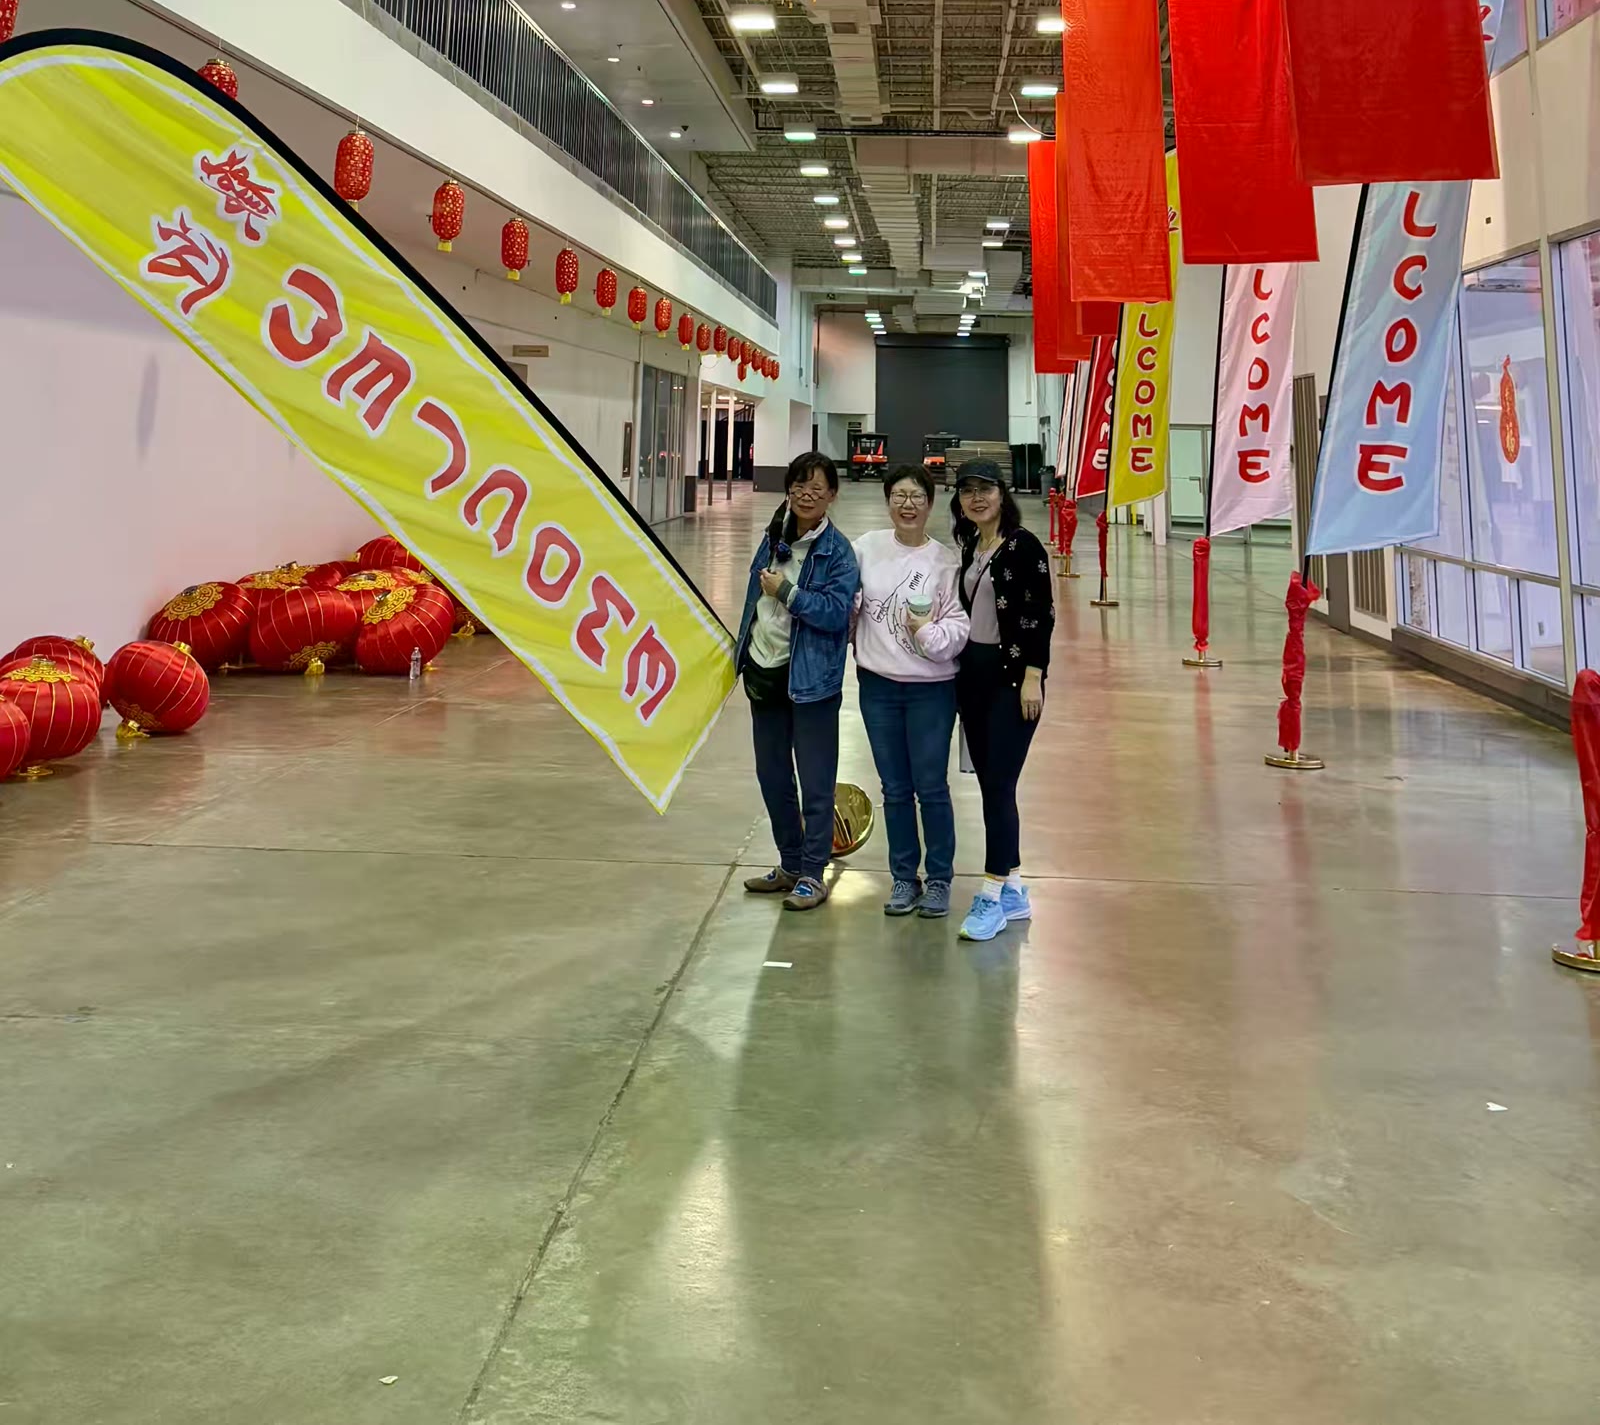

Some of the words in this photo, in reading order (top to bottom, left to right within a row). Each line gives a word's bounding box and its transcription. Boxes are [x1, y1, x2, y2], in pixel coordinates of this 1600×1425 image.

[1130, 312, 1158, 473] LCOME
[1238, 268, 1273, 484] LCOME
[1358, 191, 1437, 492] LCOME
